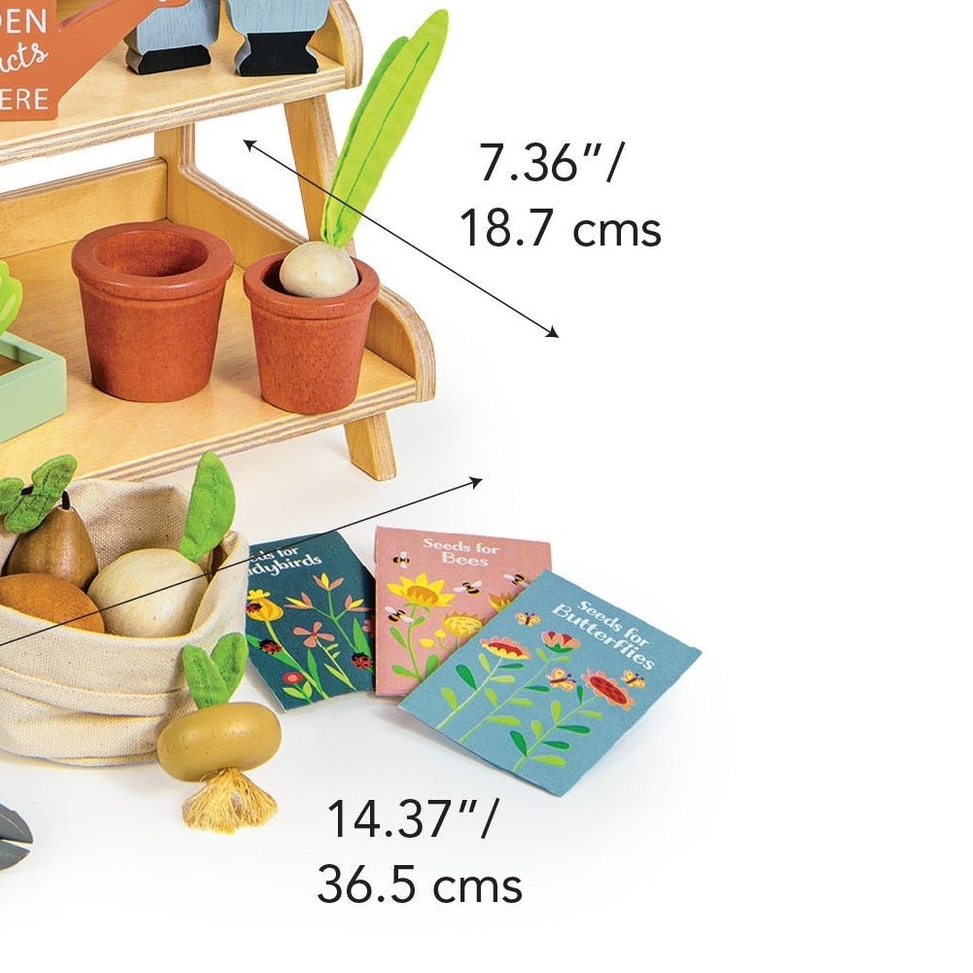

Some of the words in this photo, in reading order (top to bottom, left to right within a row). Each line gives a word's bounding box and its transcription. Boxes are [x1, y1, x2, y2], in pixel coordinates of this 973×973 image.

[423, 538, 471, 553] Seeds
[476, 543, 500, 555] for
[442, 551, 489, 567] Bees
[552, 604, 655, 671] Butterflies
[577, 601, 623, 632] Seeds
[624, 628, 650, 647] for
